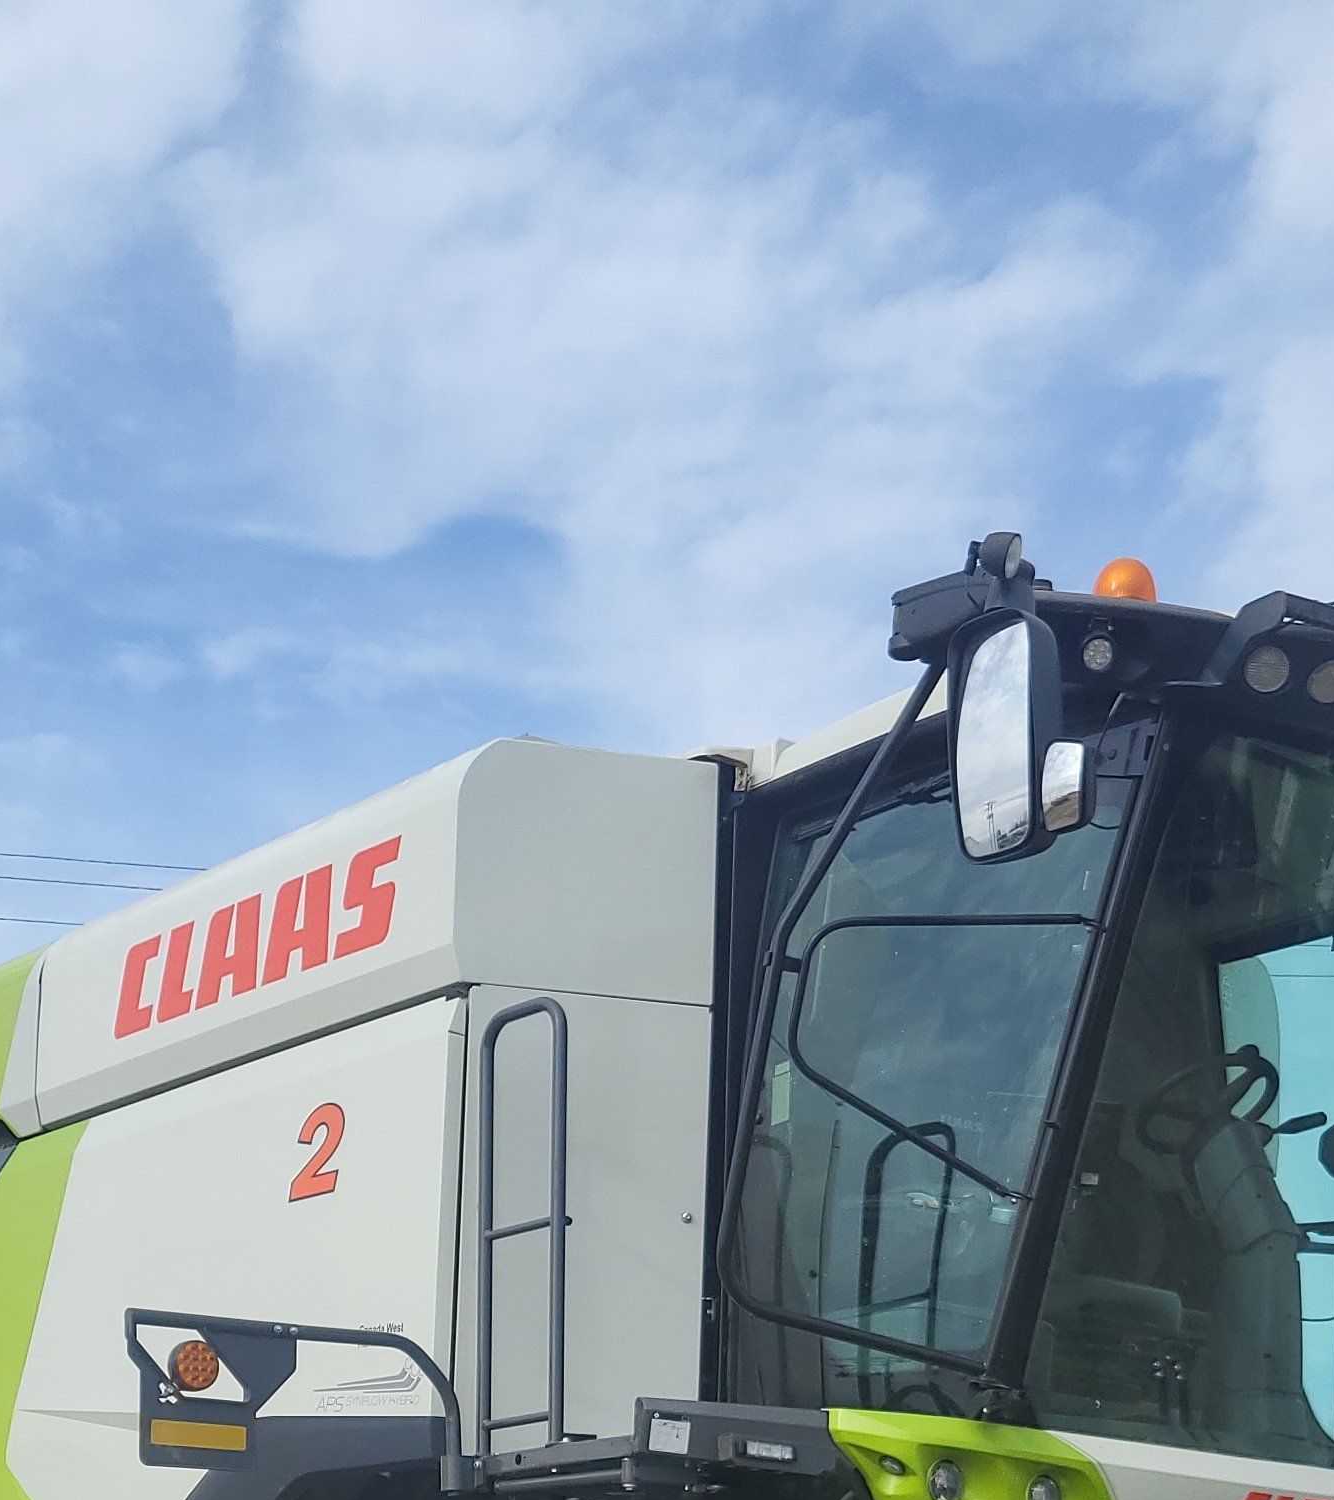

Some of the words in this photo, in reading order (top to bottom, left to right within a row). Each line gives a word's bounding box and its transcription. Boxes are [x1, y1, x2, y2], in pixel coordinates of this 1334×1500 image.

[115, 837, 402, 1039] CLAAS
[288, 1102, 346, 1203] 2
[387, 1322, 404, 1333] West
[316, 1396, 344, 1412] APS
